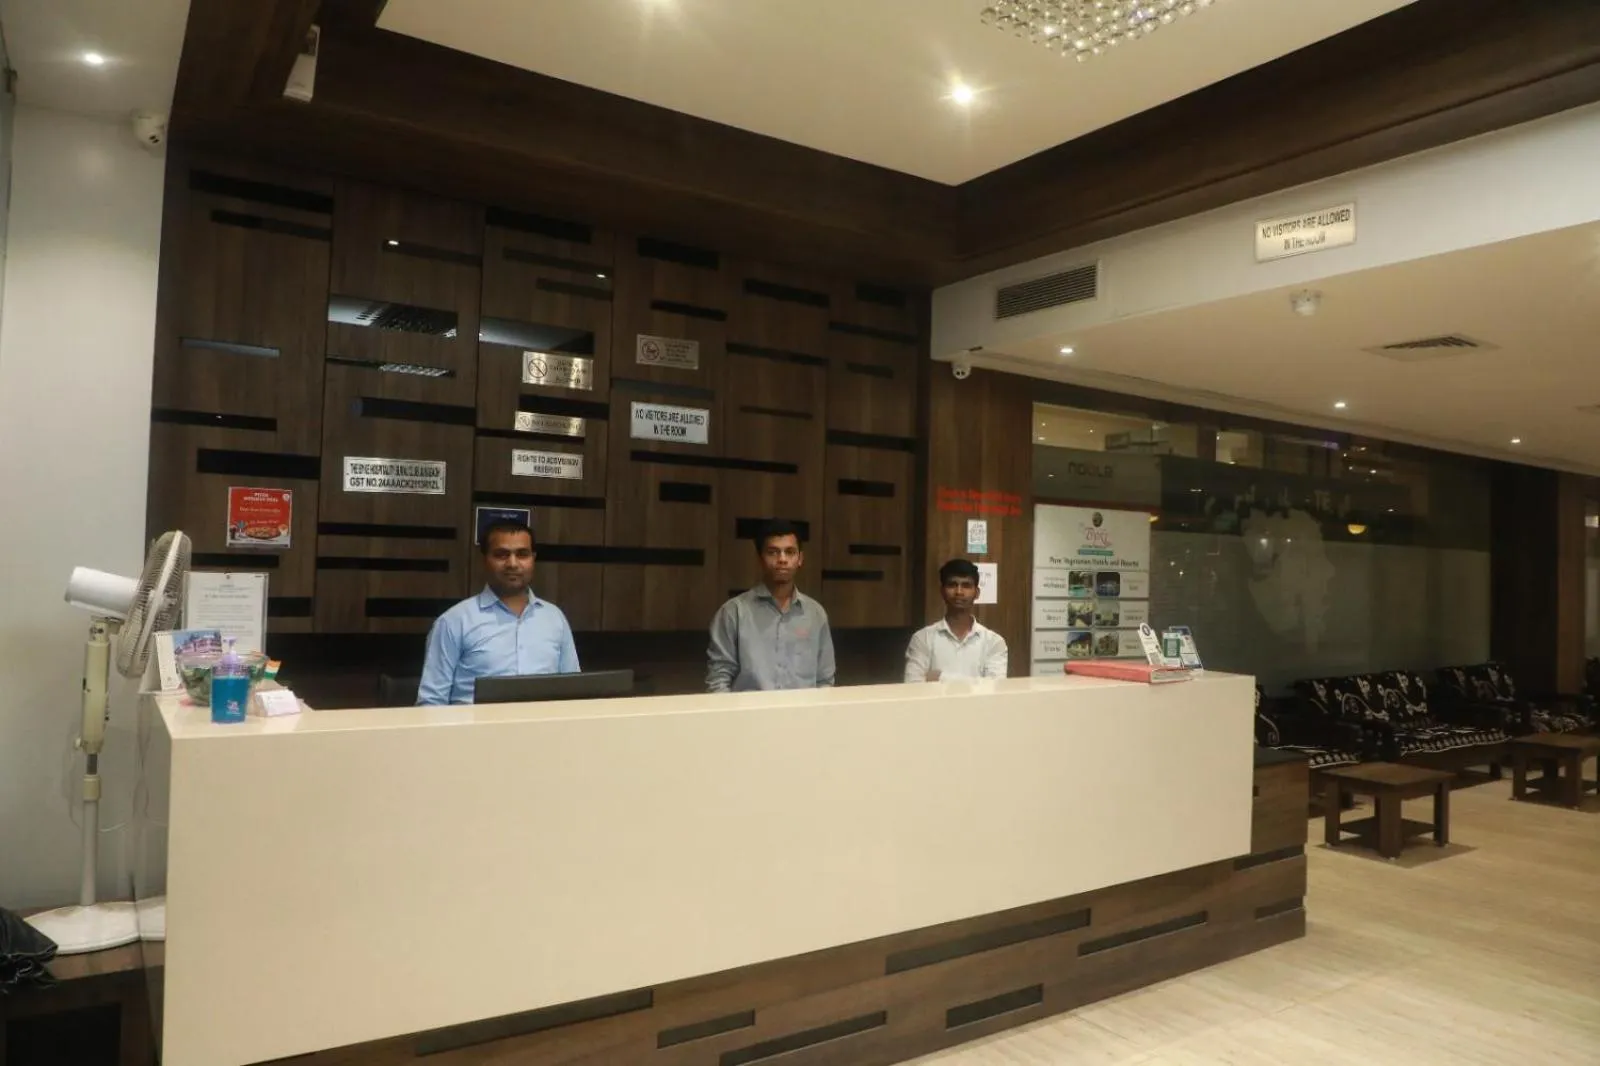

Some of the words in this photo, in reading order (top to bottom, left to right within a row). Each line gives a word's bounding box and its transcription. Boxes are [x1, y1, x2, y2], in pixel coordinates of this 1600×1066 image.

[1262, 226, 1272, 239] NO
[1272, 219, 1301, 237] VISITORS
[1302, 216, 1317, 229] ARE
[1317, 207, 1351, 226] ALLOWED
[1283, 238, 1291, 250] IN
[1291, 236, 1305, 249] THE
[635, 408, 644, 420] NO
[645, 409, 668, 421] VISITORS
[668, 411, 680, 423] ARE
[680, 413, 705, 426] ALLOWED
[653, 423, 659, 434] IN
[660, 424, 670, 436] THE
[670, 425, 687, 437] ROOM
[537, 455, 546, 464] TO
[349, 477, 364, 487] GST
